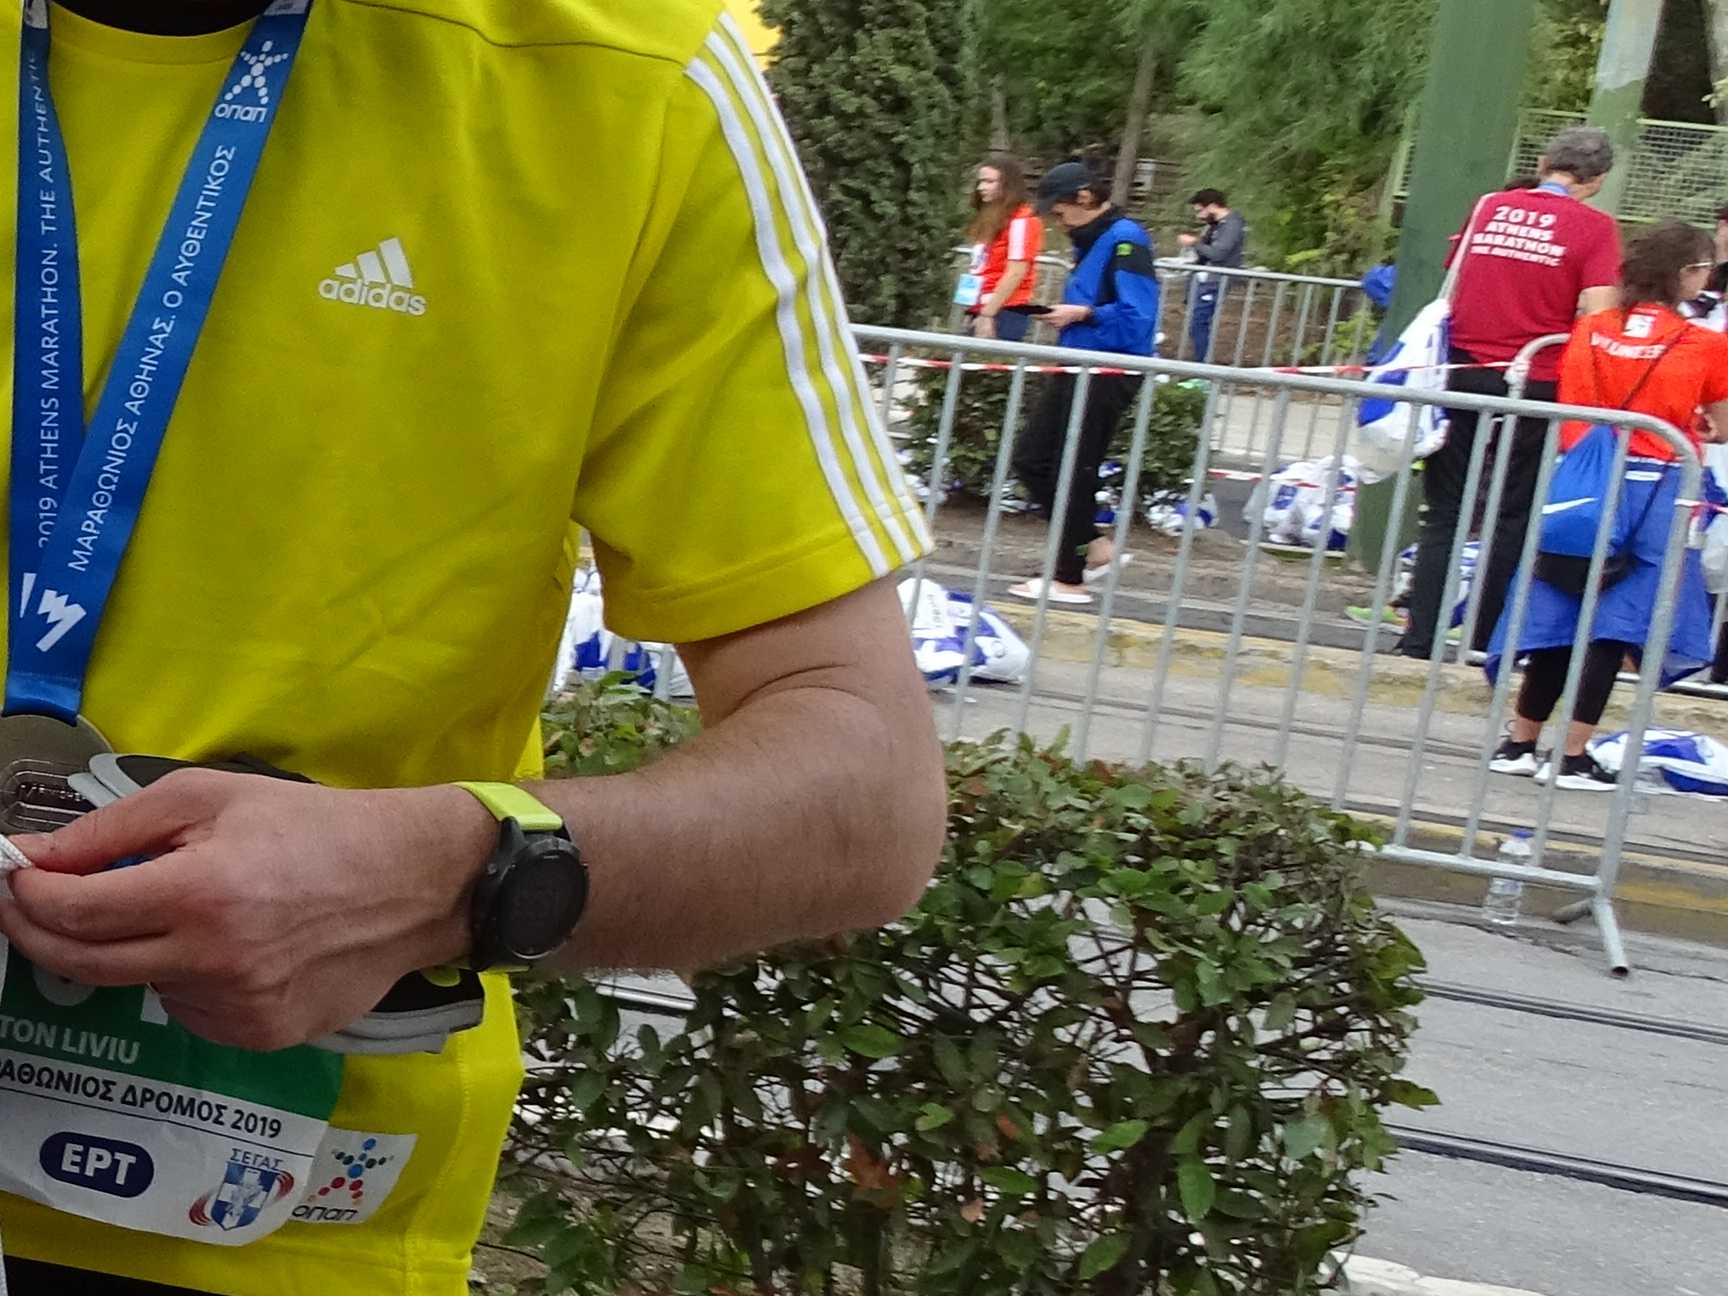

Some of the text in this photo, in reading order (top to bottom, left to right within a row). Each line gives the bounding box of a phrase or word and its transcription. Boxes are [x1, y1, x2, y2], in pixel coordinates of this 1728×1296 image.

[41, 191, 56, 235] THE
[1485, 221, 1555, 241] ATHENS
[1493, 205, 1557, 227] 2019
[1472, 232, 1567, 258] MARATHON
[40, 242, 60, 392] MARATHON.
[319, 278, 427, 316] adidas
[68, 418, 138, 571] ΜΑΡΑΘΩΝΙΟΣ
[124, 315, 176, 415] ΑΘΗΝΑΣ.
[172, 145, 236, 286] ΑΥΘΕΝΤΙΚΟΣ
[38, 397, 59, 491] ATHENS
[61, 1029, 141, 1064] LIVIU
[120, 1084, 228, 1126] ΔΡΟΜΟΣ
[231, 1108, 282, 1139] 2019
[61, 1142, 137, 1186] ΕΡΤ
[230, 1147, 285, 1171] ΣΕΓΑΣ
